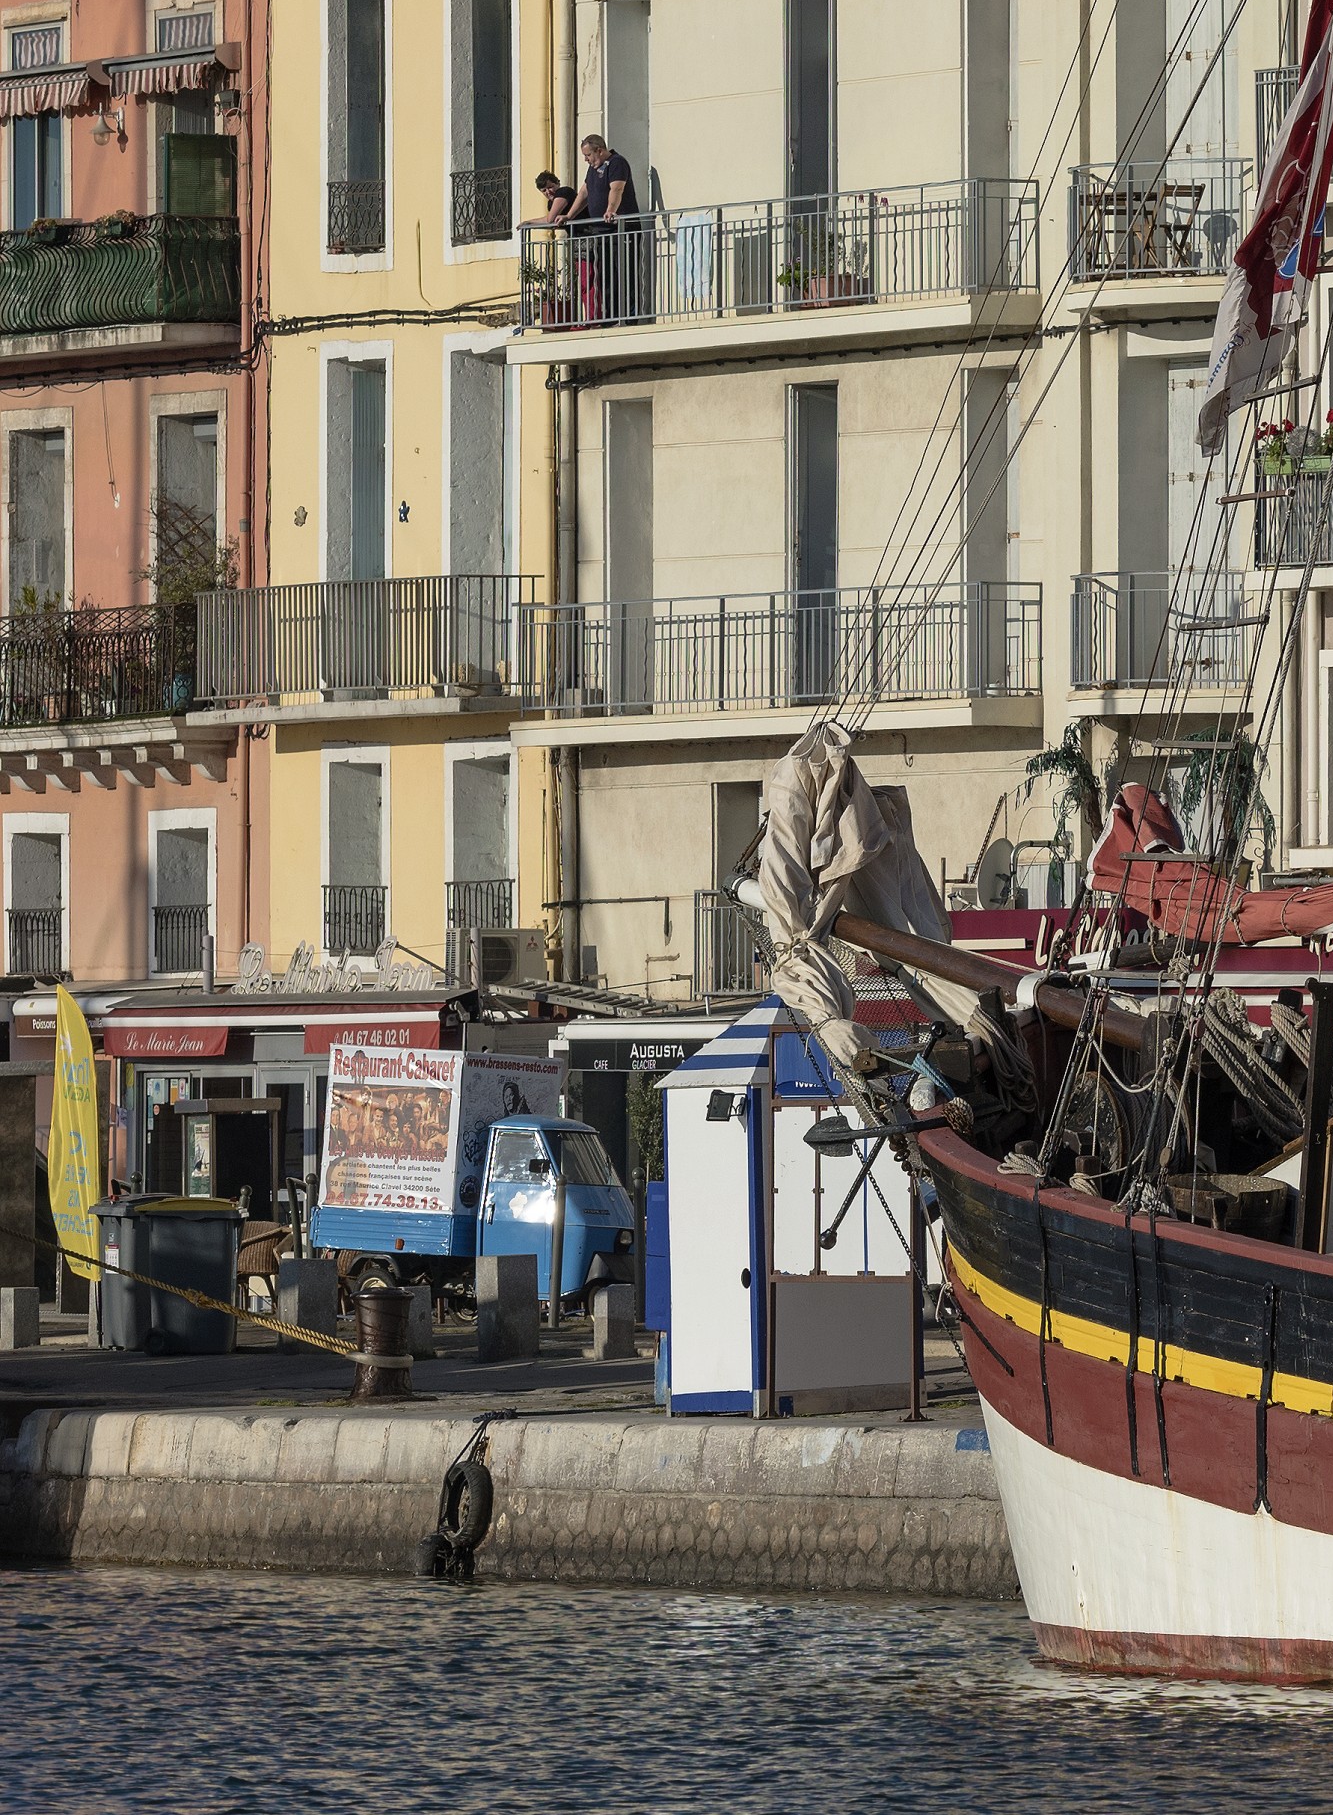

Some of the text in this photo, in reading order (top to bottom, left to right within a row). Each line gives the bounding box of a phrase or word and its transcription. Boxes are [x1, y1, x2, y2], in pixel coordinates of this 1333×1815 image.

[231, 935, 435, 994] Le Marie Jean
[32, 1018, 56, 1030] Poissons
[124, 1032, 205, 1054] Le Marie Jean
[342, 1028, 410, 1046] 04 67 46 02 01
[333, 1048, 456, 1082] Restaurant-Cabaret
[468, 1057, 559, 1075] www.brassens-resto.com
[594, 1059, 657, 1070] CAFE GLACIER
[337, 1170, 367, 1178] chansons
[368, 1172, 401, 1181] françaises
[367, 1163, 396, 1171] chantent
[407, 1164, 421, 1172] plus
[422, 1165, 441, 1173] belles
[352, 1181, 380, 1190] Maurice
[381, 1183, 402, 1191] Clavel
[403, 1184, 424, 1192] 34200
